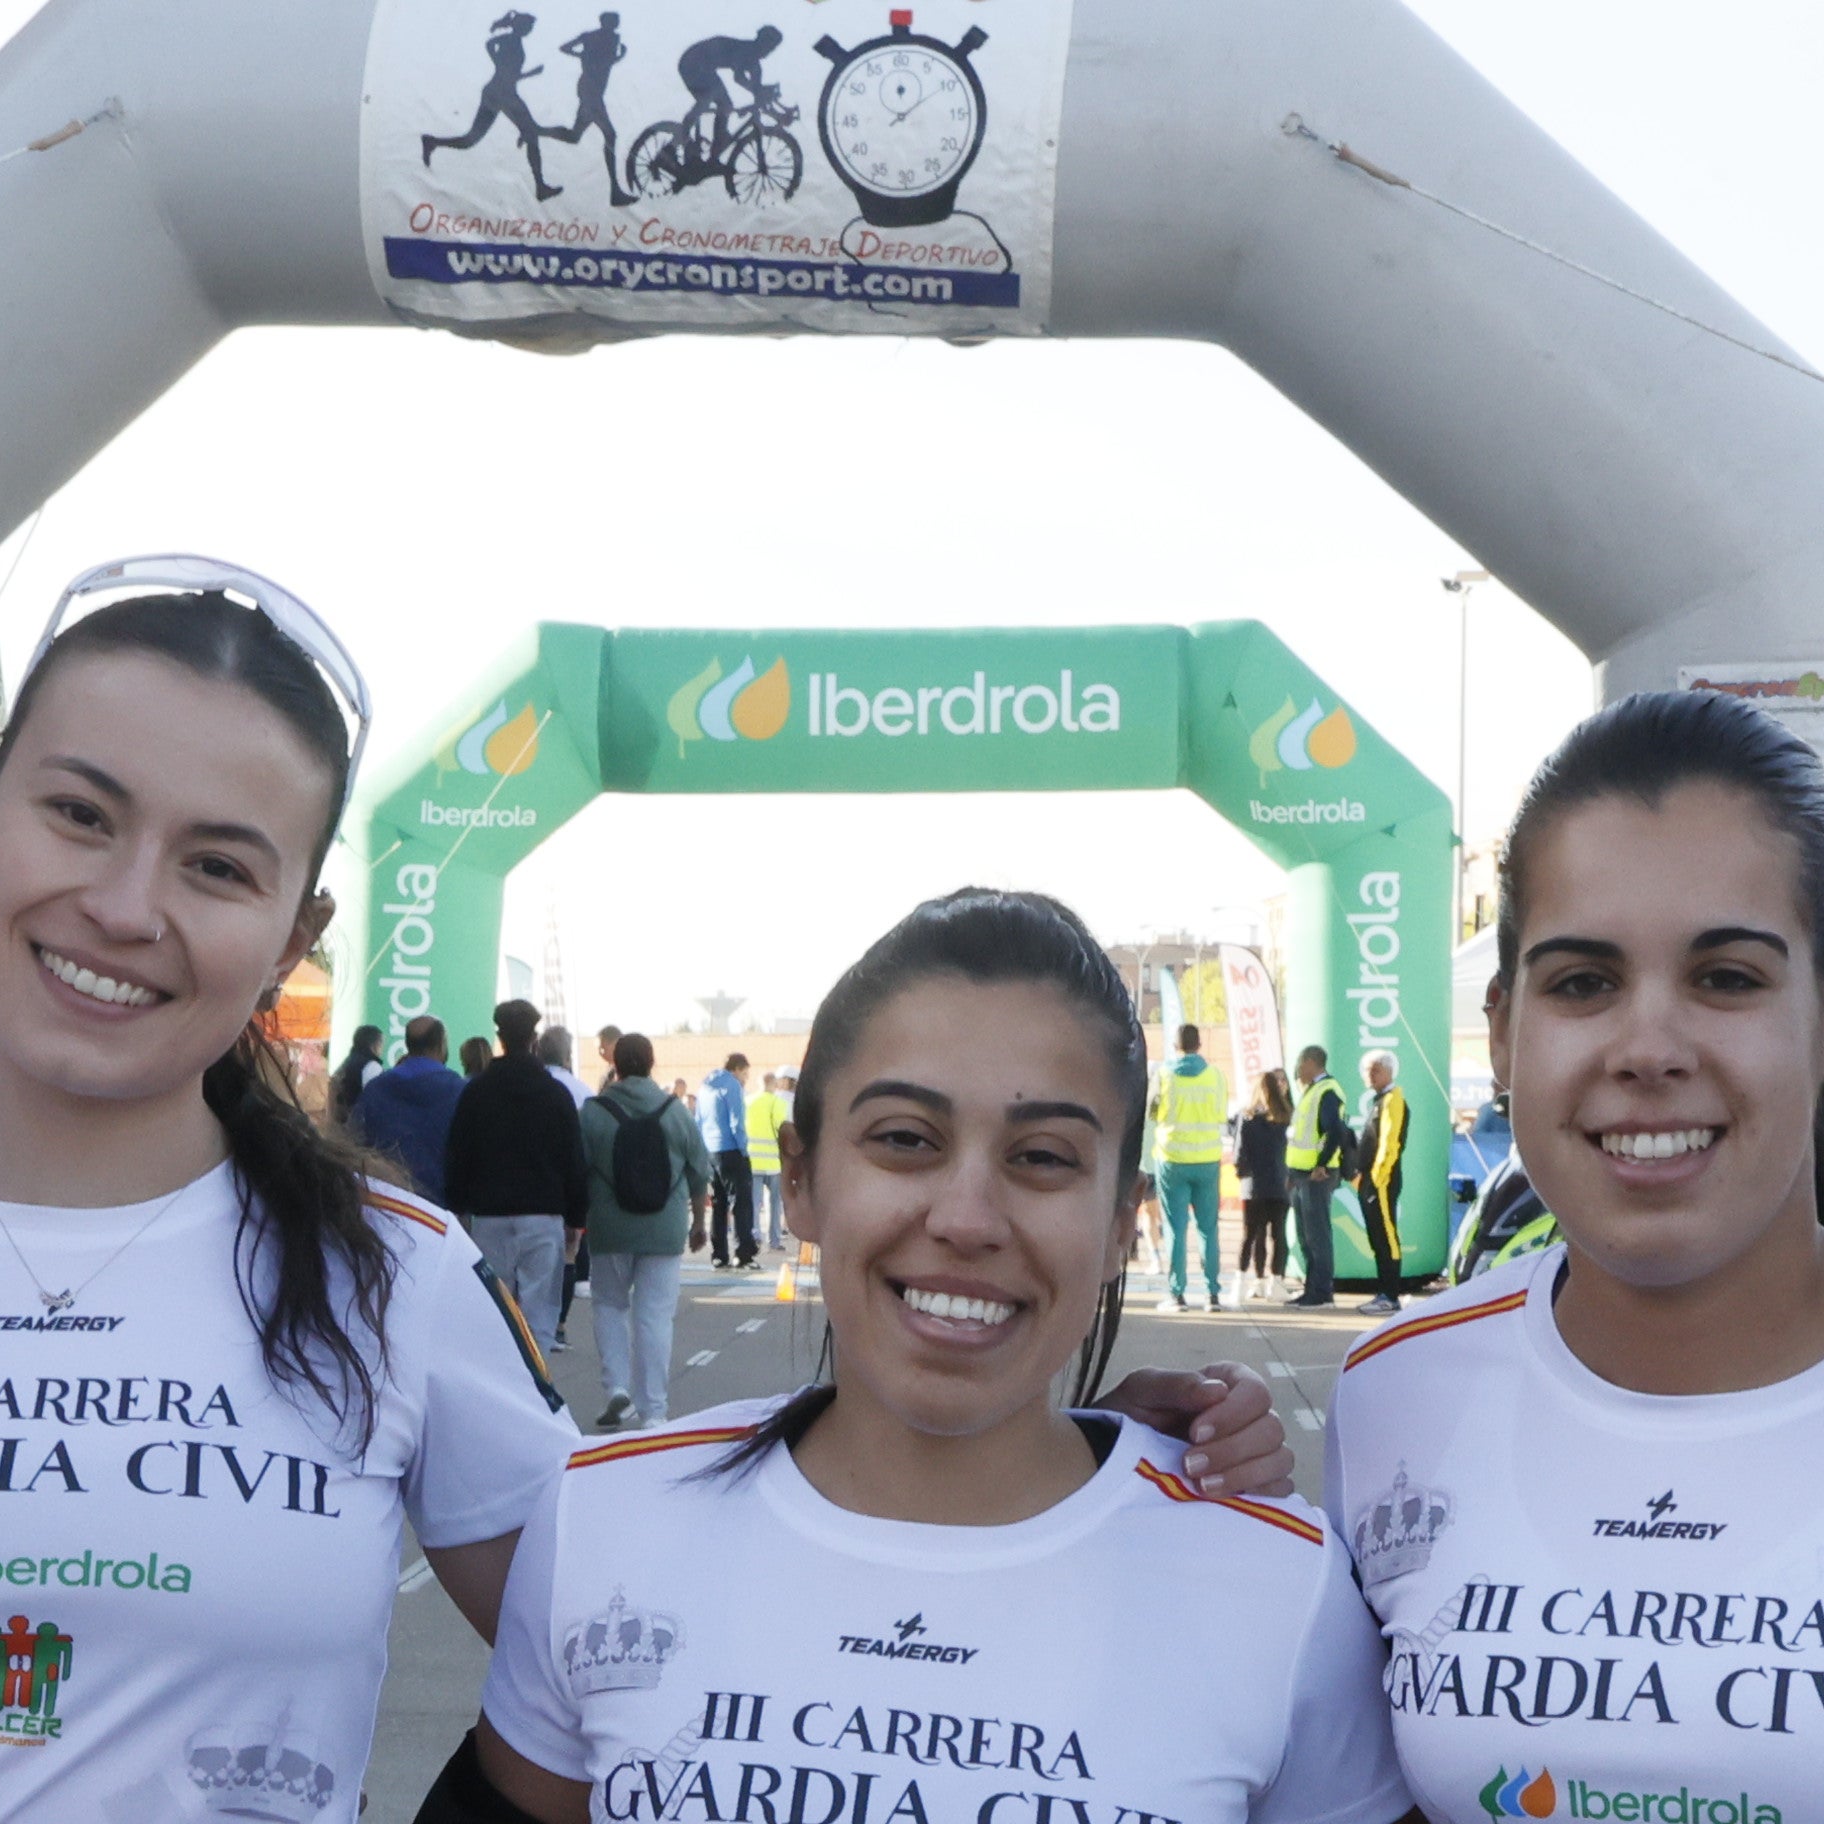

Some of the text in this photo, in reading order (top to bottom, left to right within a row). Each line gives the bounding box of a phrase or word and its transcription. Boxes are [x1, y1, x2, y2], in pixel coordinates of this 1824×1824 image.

[892, 54, 910, 67] 60
[923, 62, 931, 74] 5
[940, 79, 957, 92] 10
[842, 113, 858, 128] 45
[950, 108, 965, 121] 15
[851, 142, 868, 156] 40
[940, 136, 957, 152] 20
[855, 230, 999, 267] DEPORTIVO
[446, 249, 953, 301] www.orycronsport.com
[806, 670, 1122, 740] Iberdrola
[420, 799, 537, 828] Iberdrola
[1249, 798, 1365, 824] Iberdrola
[126, 1440, 341, 1519] CIVIL
[1592, 1518, 1728, 1541] TEAMERGY
[1454, 1582, 1526, 1634] III
[837, 1634, 980, 1666] TEAMERGY
[701, 1691, 1096, 1781] III CARRERA
